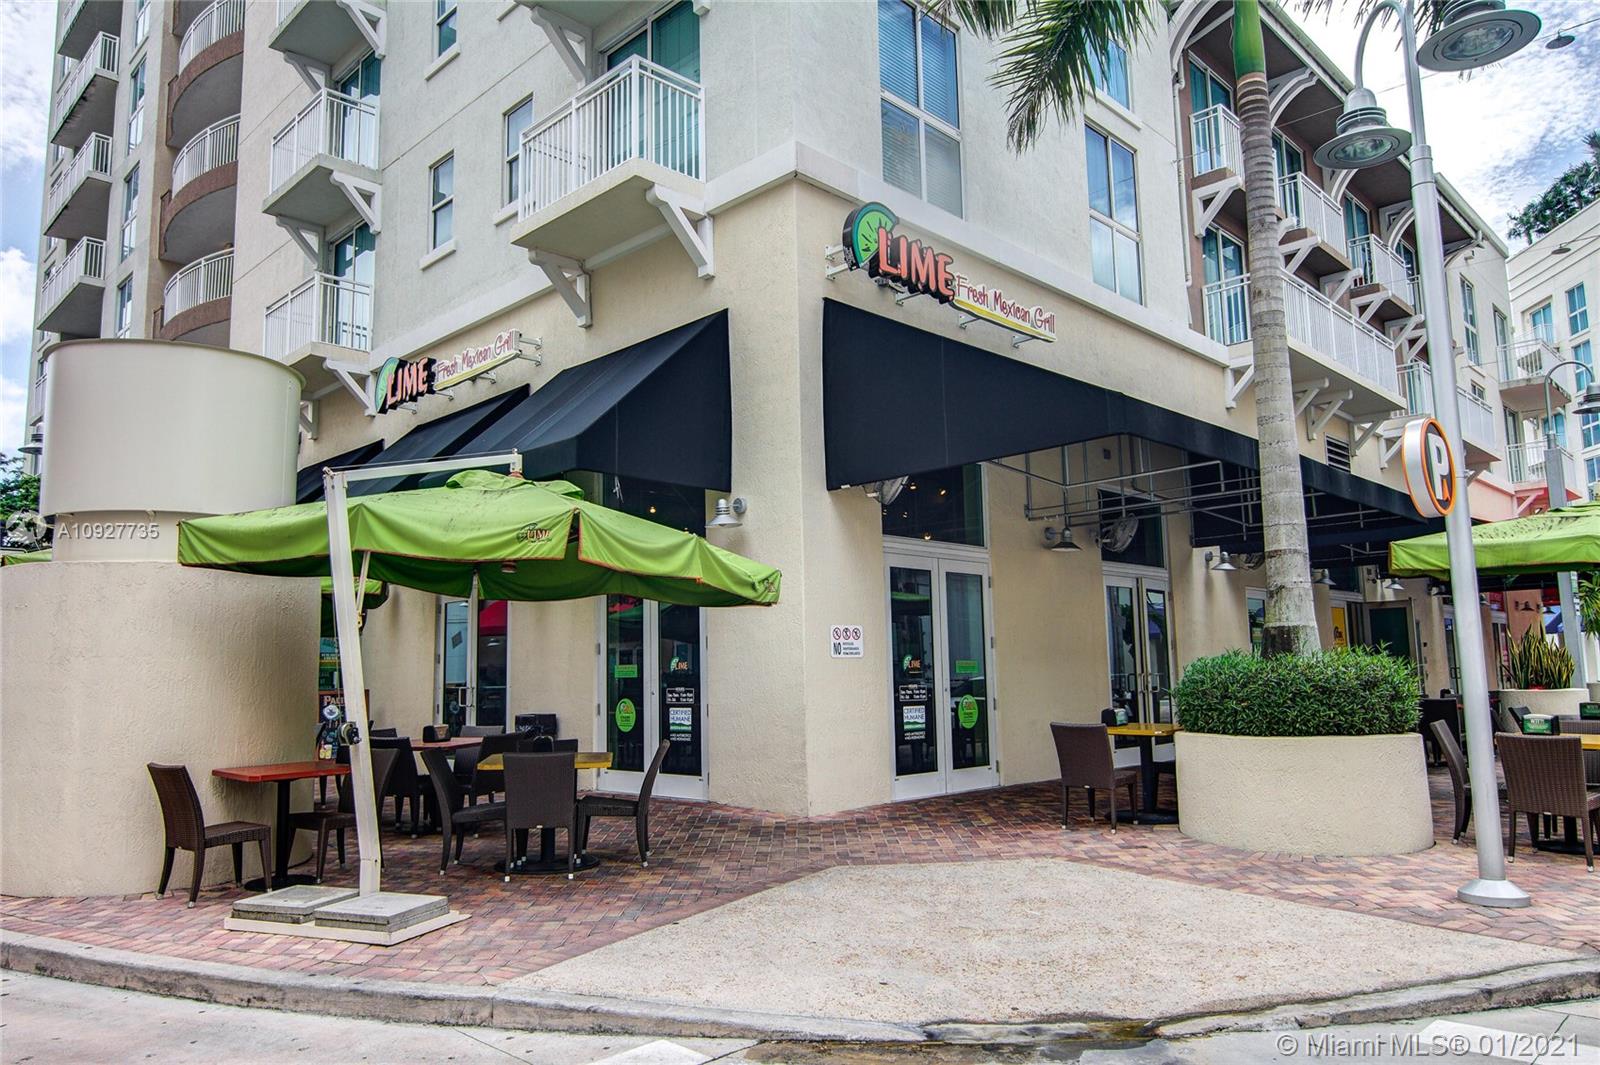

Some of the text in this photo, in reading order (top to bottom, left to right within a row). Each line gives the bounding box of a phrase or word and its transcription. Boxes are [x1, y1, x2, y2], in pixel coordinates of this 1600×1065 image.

[878, 226, 955, 297] LIME
[956, 274, 1055, 334] Fresh Mexican Grill
[386, 357, 430, 405] LIME
[436, 331, 513, 379] Fresh Mexican Grill
[1427, 432, 1450, 501] P
[833, 641, 842, 656] NO
